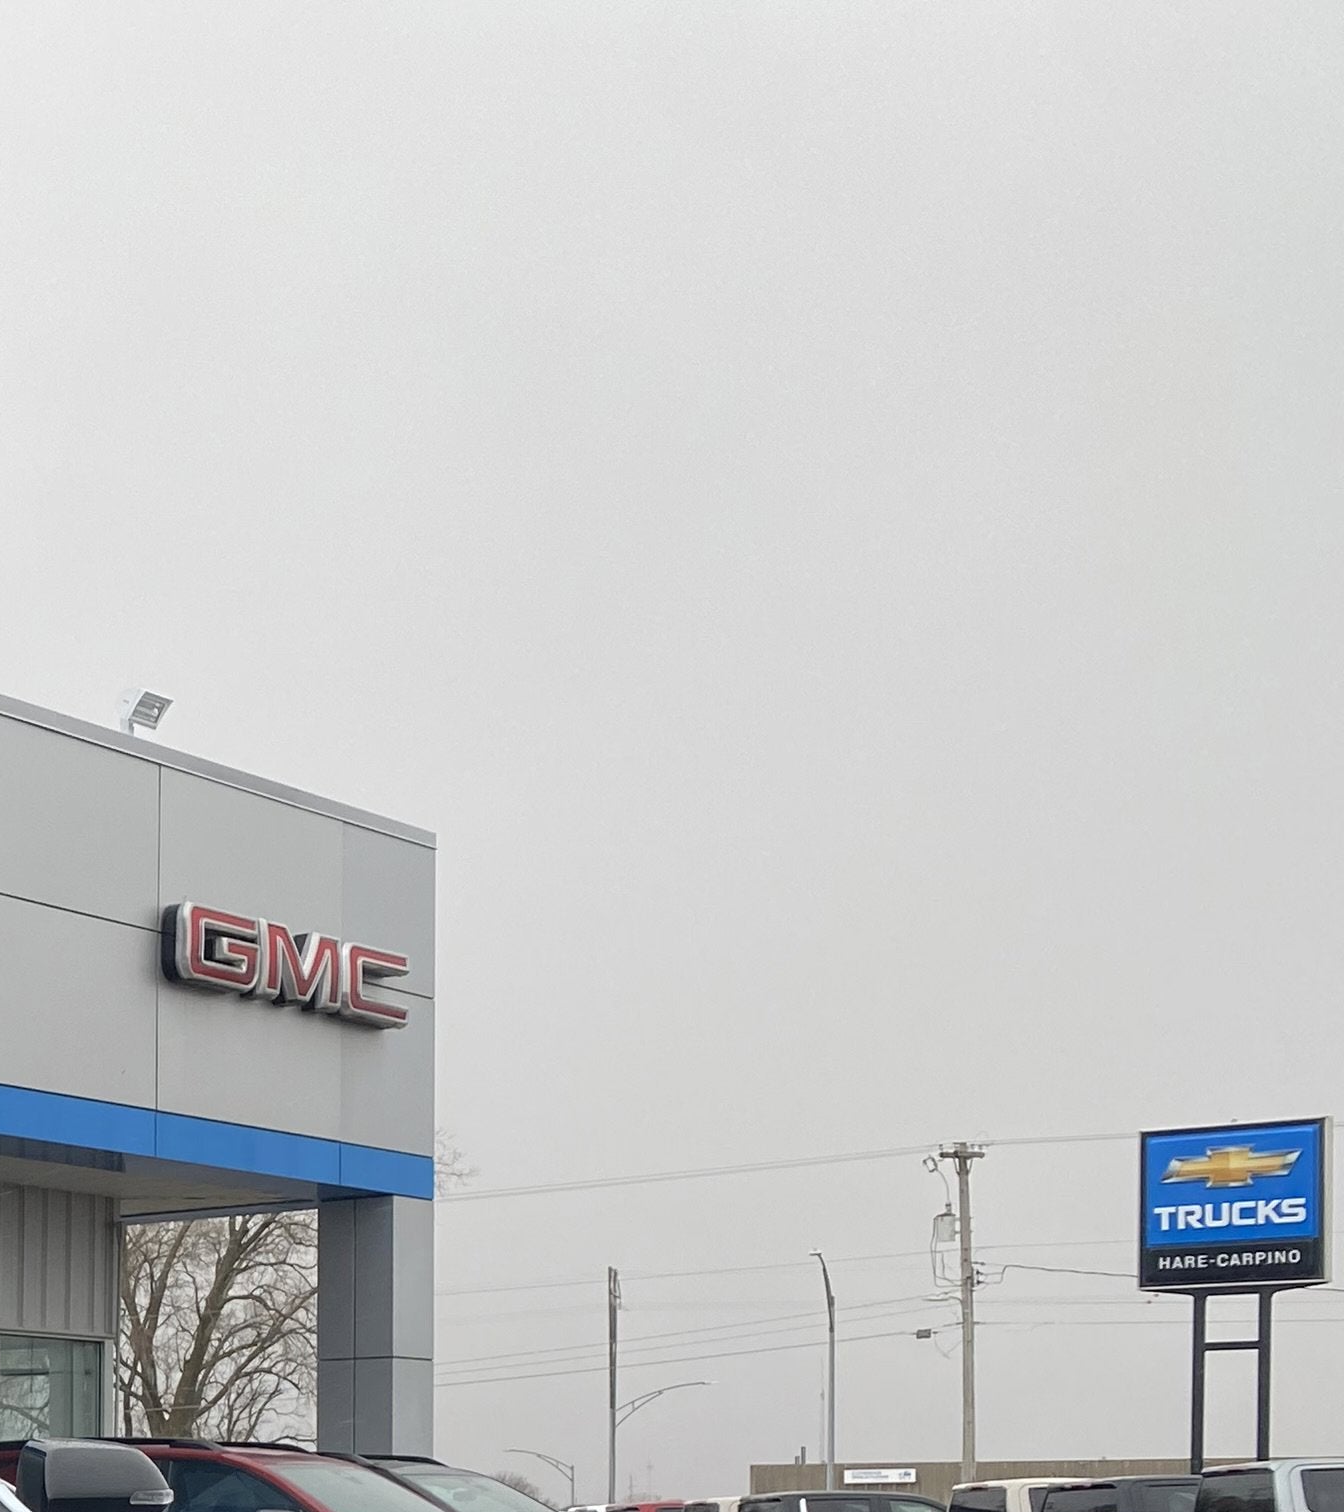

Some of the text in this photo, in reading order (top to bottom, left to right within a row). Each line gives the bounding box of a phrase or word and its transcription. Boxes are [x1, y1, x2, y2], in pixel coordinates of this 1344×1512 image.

[162, 901, 410, 1029] GMC
[1154, 1198, 1307, 1231] TRUCKS
[1158, 1249, 1301, 1270] HARE-CARPINO
